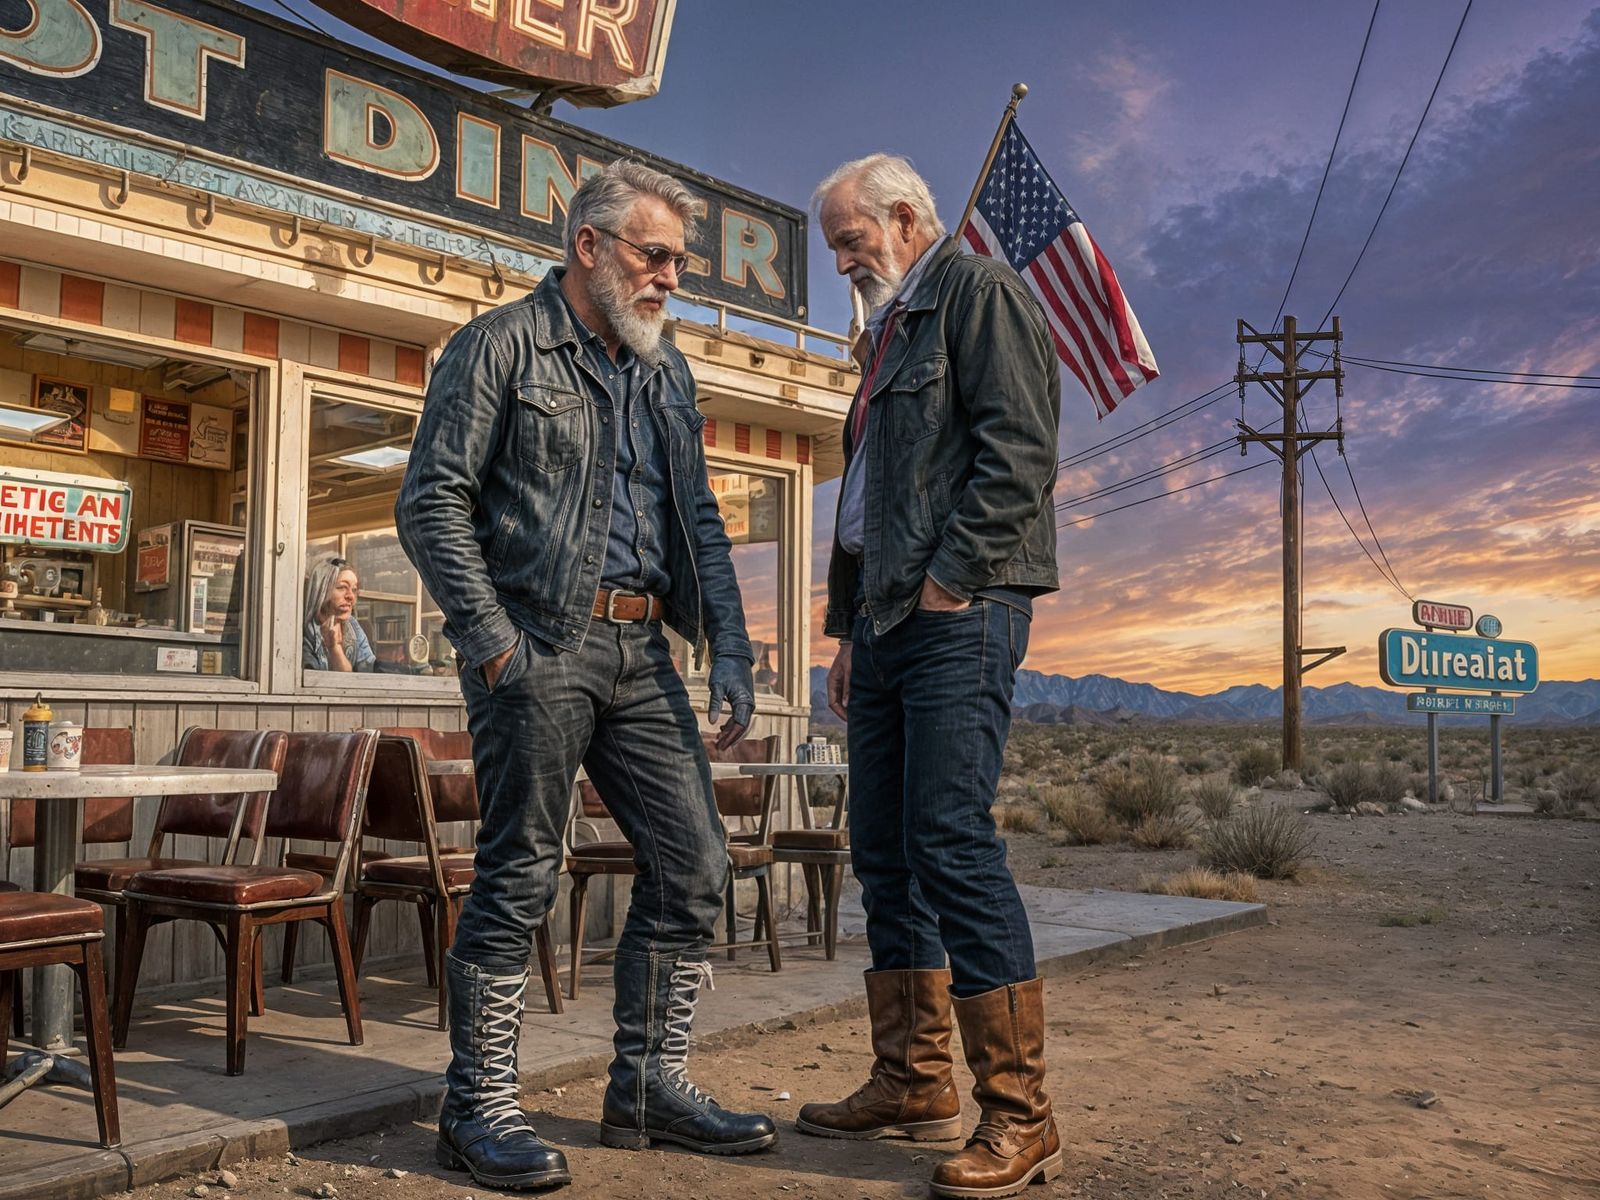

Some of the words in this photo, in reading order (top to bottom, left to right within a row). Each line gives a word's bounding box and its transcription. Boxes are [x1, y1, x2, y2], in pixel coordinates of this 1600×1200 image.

[323, 67, 787, 300] DINR
[77, 494, 122, 521] AN
[0, 511, 121, 545] IHETENTS
